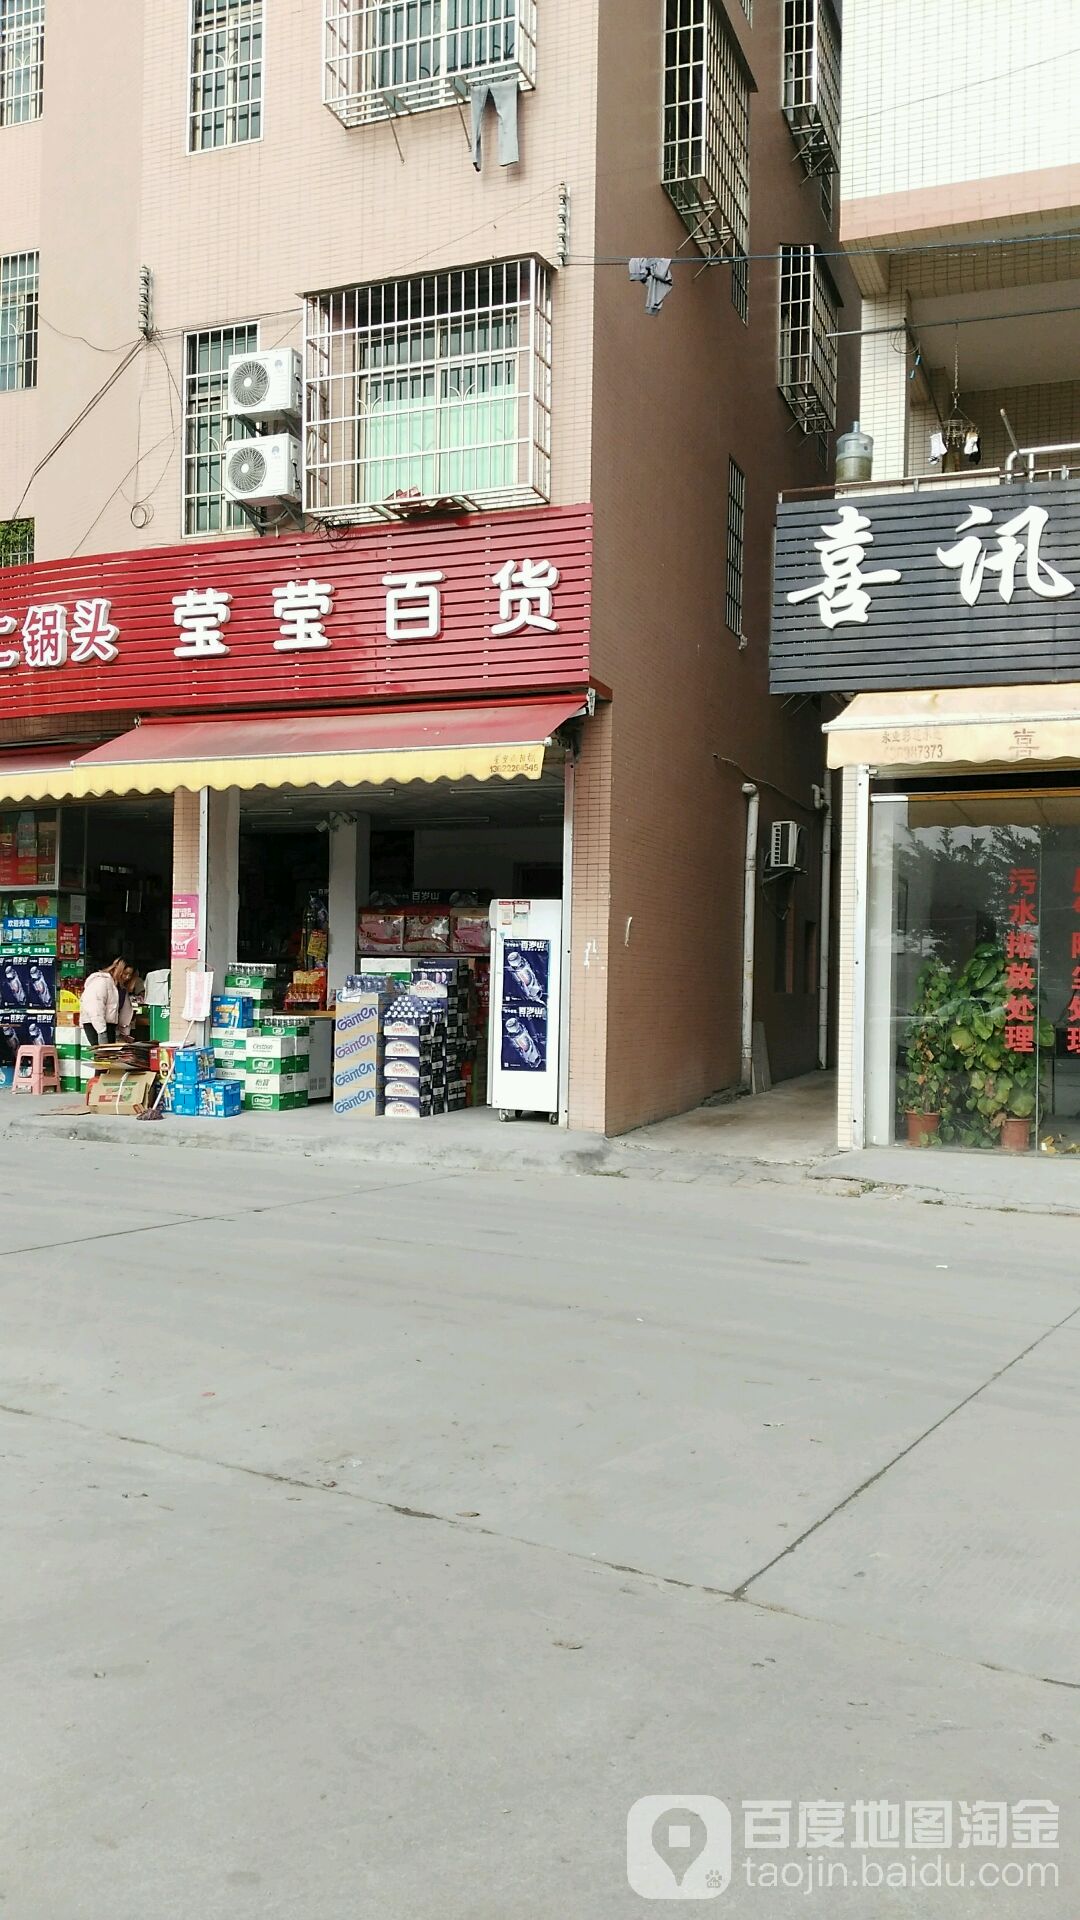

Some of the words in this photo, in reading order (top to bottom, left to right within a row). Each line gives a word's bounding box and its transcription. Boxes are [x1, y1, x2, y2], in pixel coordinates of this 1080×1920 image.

[171, 558, 561, 660] 莹莹百货
[786, 505, 1076, 629] 喜讯
[412, 891, 440, 900] 百岁山
[1004, 867, 1037, 1054] 污水排放处理
